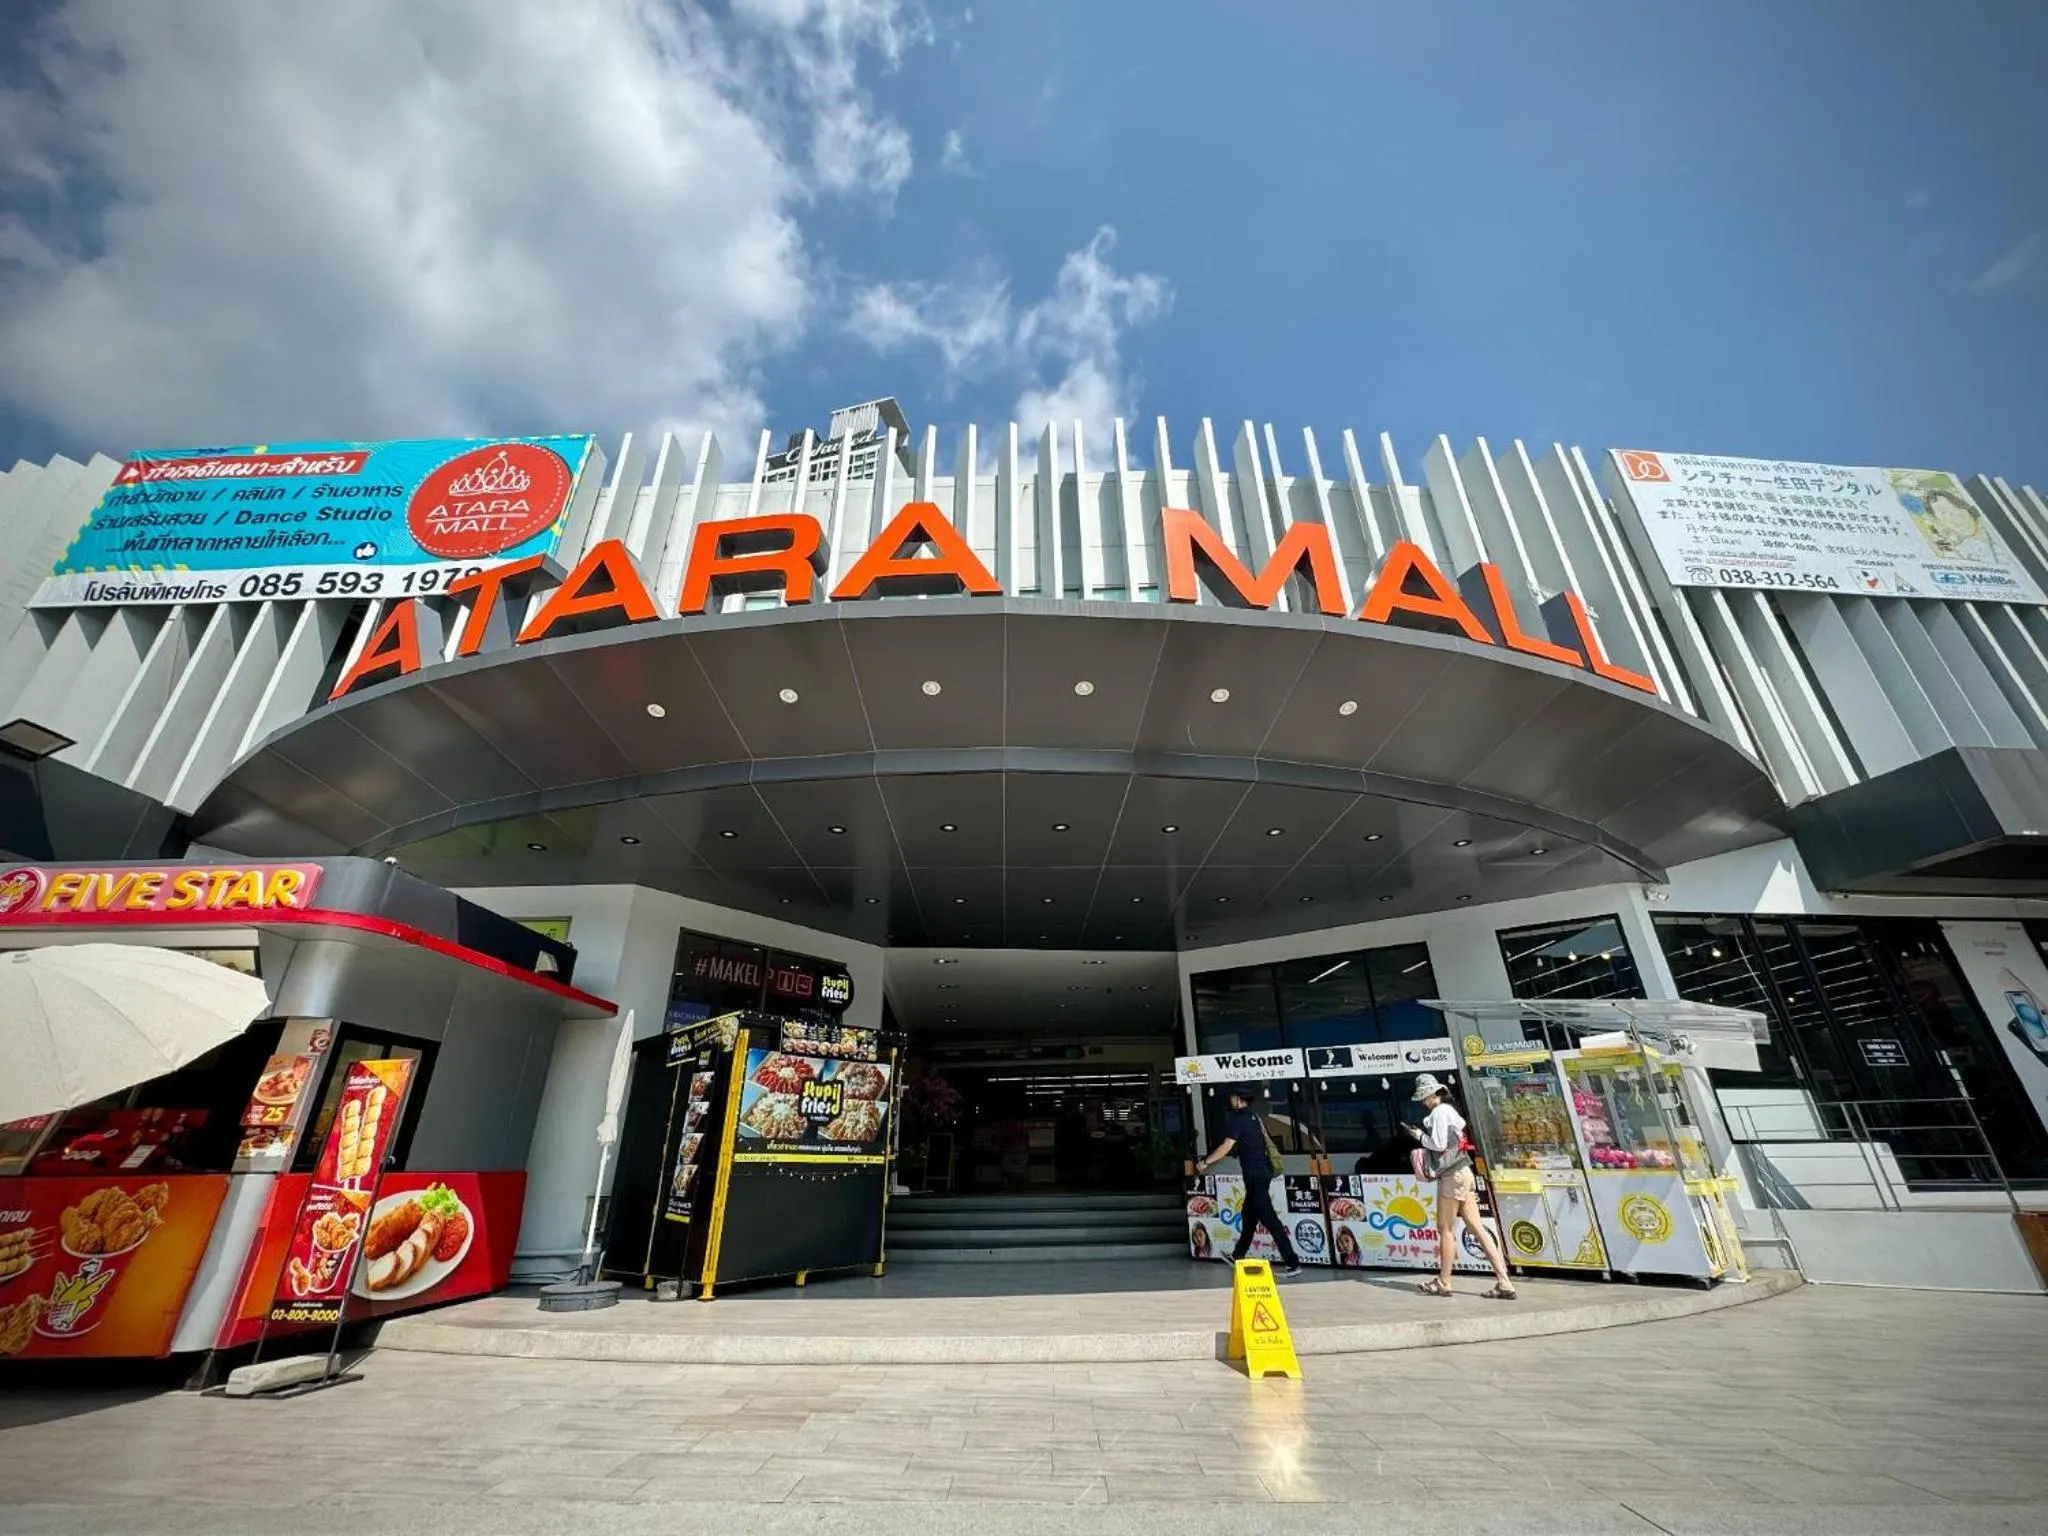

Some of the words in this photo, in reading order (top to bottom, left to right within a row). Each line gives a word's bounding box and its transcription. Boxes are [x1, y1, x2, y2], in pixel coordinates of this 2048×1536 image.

[1681, 469, 1883, 496] シラチャー生田デンタル
[231, 485, 286, 502] คลินิก
[311, 483, 405, 500] ร้านอาหาร
[233, 509, 308, 526] Dance
[315, 506, 393, 523] Studio
[426, 500, 530, 518] ATARA
[433, 517, 517, 536] MALL
[83, 579, 227, 602] โปรลับพิเศษโทร
[239, 573, 301, 598] 085
[316, 572, 383, 595] 593
[1719, 568, 1840, 589] 038-312-564
[330, 502, 1003, 701] ATARA
[1161, 507, 1658, 695] MALL
[40, 872, 168, 912] FIVE
[165, 869, 305, 910] STAR
[1214, 1053, 1294, 1070] Welcome
[1358, 1052, 1399, 1062] Welcome
[262, 1106, 287, 1123] 25
[271, 1309, 339, 1321] 02-800-8000
